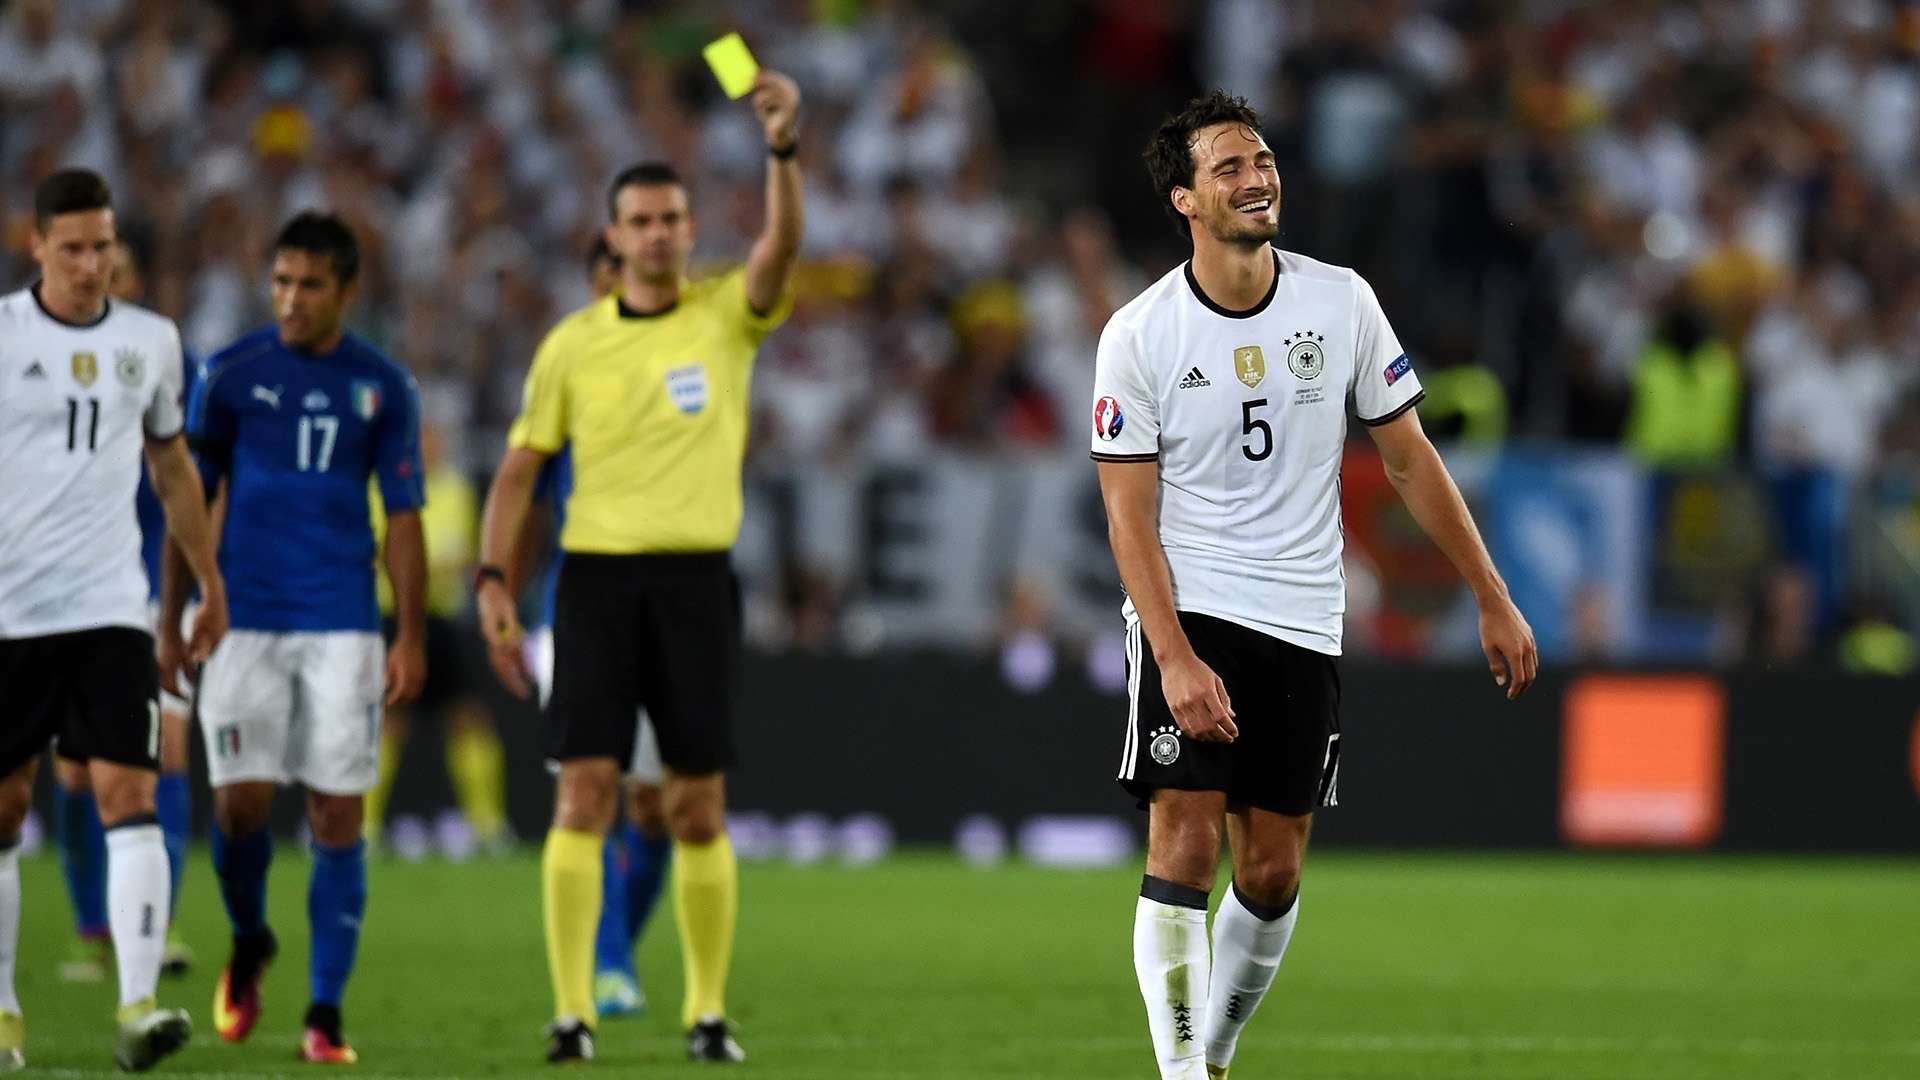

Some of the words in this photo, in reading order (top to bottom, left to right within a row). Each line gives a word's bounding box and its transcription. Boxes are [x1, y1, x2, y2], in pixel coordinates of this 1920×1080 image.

[1179, 379, 1211, 390] adidas
[67, 397, 98, 451] 11
[298, 416, 338, 472] 17
[1242, 398, 1273, 462] 5
